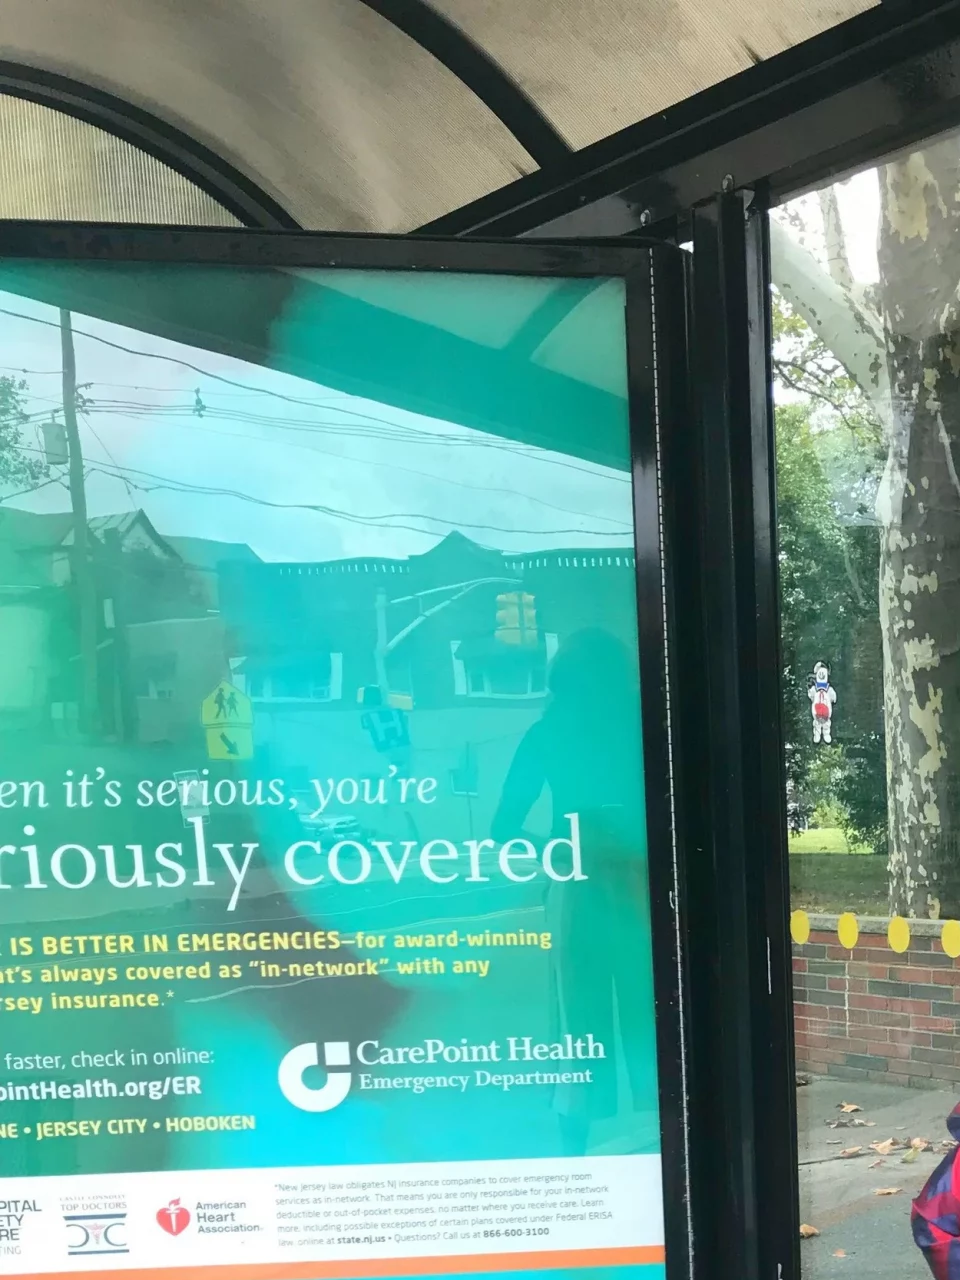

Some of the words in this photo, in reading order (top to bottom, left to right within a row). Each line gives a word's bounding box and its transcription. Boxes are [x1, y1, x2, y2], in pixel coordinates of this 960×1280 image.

[62, 767, 122, 808] it's
[136, 768, 298, 811] serious,
[309, 764, 438, 819] you're
[283, 812, 589, 885] covered
[10, 937, 33, 956] IS
[42, 934, 135, 955] BETTER
[143, 934, 169, 953] IN
[393, 929, 552, 949] award-winning
[40, 965, 118, 986] always
[125, 962, 211, 981] covered
[218, 964, 242, 979] as
[397, 957, 446, 975] with
[452, 959, 490, 978] any
[0, 996, 43, 1015] sey
[4, 1052, 66, 1070] faster,
[71, 1050, 125, 1069] check
[130, 1049, 148, 1066] in
[153, 1048, 215, 1065] online:
[356, 1038, 501, 1066] CarePoint
[506, 1034, 606, 1061] Health
[359, 1072, 471, 1094] Emergency
[474, 1068, 593, 1090] Department
[36, 1120, 101, 1141] JERSEY
[107, 1118, 148, 1135] CITY
[165, 1115, 256, 1132] HOBOKEN
[300, 1182, 326, 1192] Jersey
[328, 1182, 344, 1190] law
[346, 1181, 385, 1190] obligates
[399, 1179, 440, 1188] insurance
[441, 1177, 486, 1187] companies
[499, 1175, 521, 1184] cover
[523, 1173, 569, 1183] emergency
[571, 1172, 592, 1181] room
[60, 1203, 79, 1212] TOP
[82, 1201, 127, 1211] DOCTORS
[195, 1201, 246, 1210] American
[275, 1196, 310, 1206] services
[374, 1193, 394, 1203] That
[396, 1193, 425, 1201] means
[426, 1192, 442, 1202] you
[444, 1191, 458, 1200] are
[460, 1190, 478, 1200] only
[480, 1187, 528, 1199] responsible
[530, 1187, 541, 1196] for
[544, 1187, 562, 1197] your
[564, 1185, 609, 1195] in-network
[196, 1212, 236, 1223] Heart
[276, 1210, 321, 1220] deductible
[334, 1208, 392, 1218] out-of-pocket
[438, 1205, 450, 1213] no
[451, 1204, 479, 1212] matter
[482, 1203, 508, 1211] where
[510, 1202, 526, 1212] you
[528, 1200, 557, 1209] receive
[581, 1198, 604, 1207] Learn
[197, 1224, 260, 1234] Association
[303, 1222, 342, 1233] including
[344, 1221, 379, 1232] possible
[381, 1219, 427, 1230] exceptions
[439, 1218, 469, 1227] certain
[471, 1217, 493, 1227] plans
[495, 1215, 527, 1225] covered
[529, 1214, 553, 1223] under
[556, 1212, 586, 1222] Federal
[588, 1211, 613, 1220] ERISA
[298, 1237, 324, 1246] online
[337, 1235, 386, 1245] state.nj.us
[394, 1231, 441, 1243] Questions?
[443, 1231, 458, 1240] Call
[460, 1231, 471, 1239] us
[483, 1227, 550, 1239] 866-600-3100
